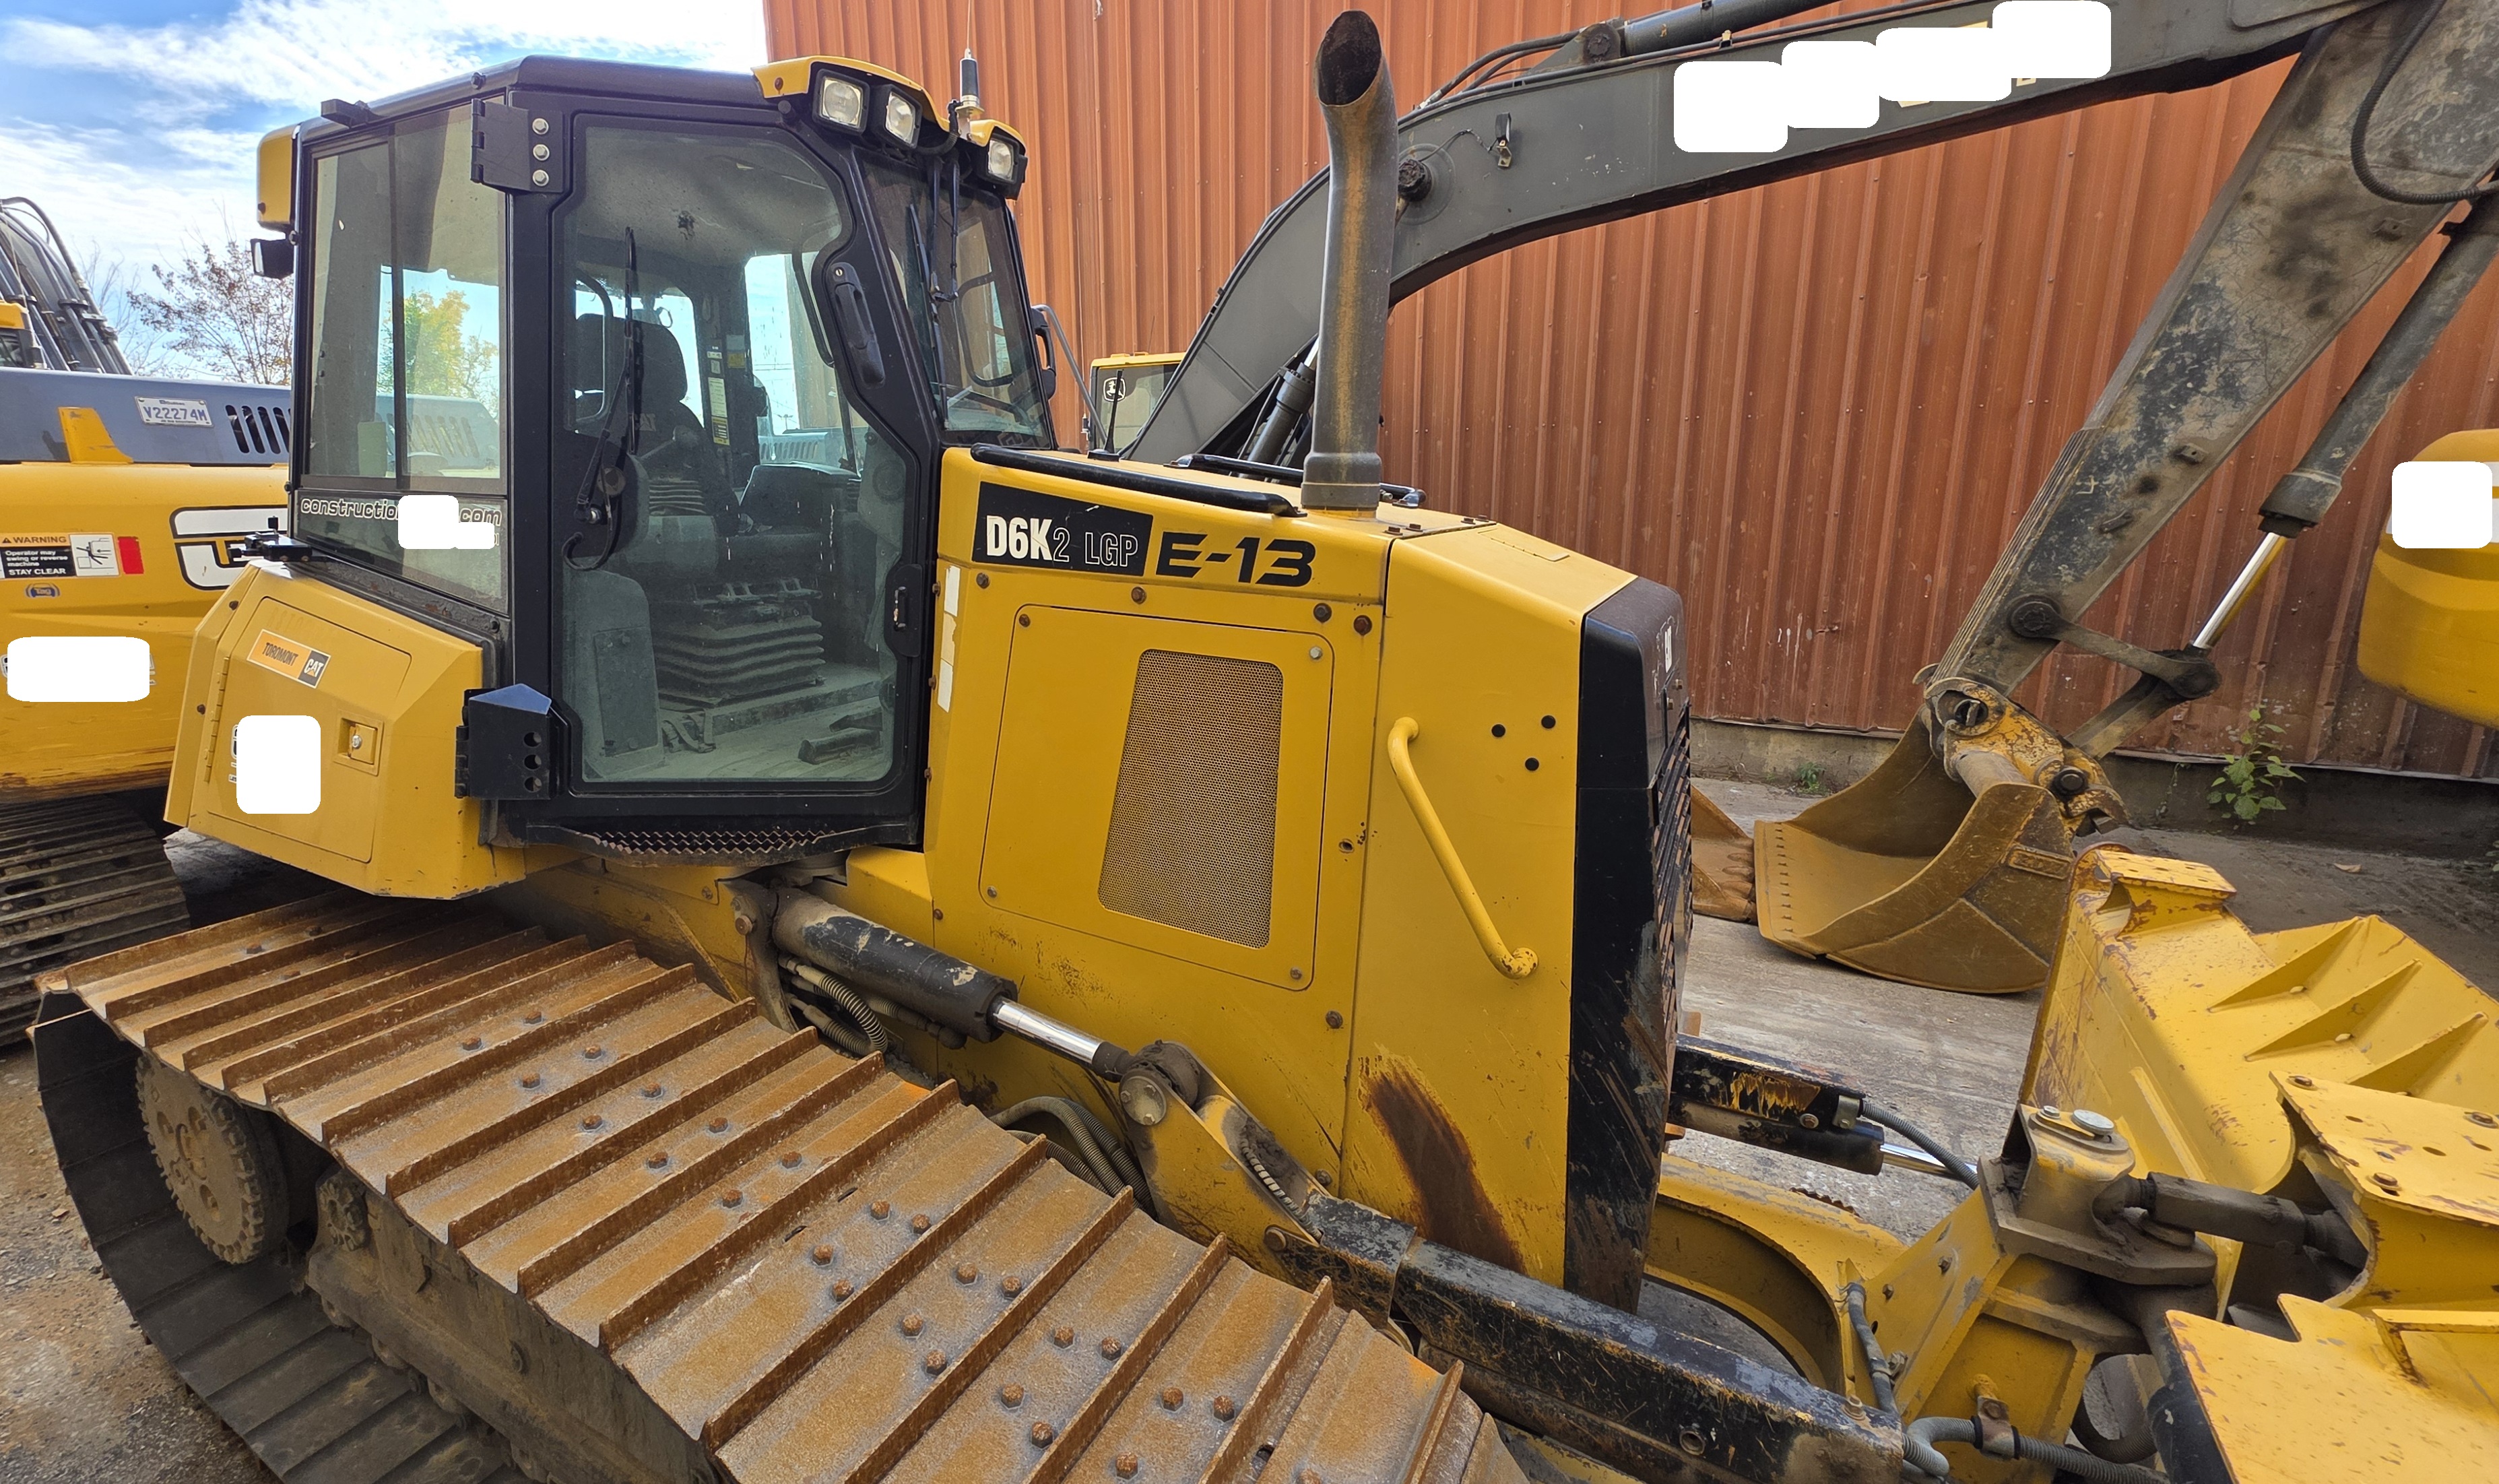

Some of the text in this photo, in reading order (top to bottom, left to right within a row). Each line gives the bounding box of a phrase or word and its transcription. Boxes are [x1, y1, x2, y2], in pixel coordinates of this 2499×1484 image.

[300, 498, 399, 521] constructio
[1085, 531, 1138, 567] LGP
[1156, 531, 1316, 587] E-13
[262, 642, 324, 678] TOROMONT CAT
